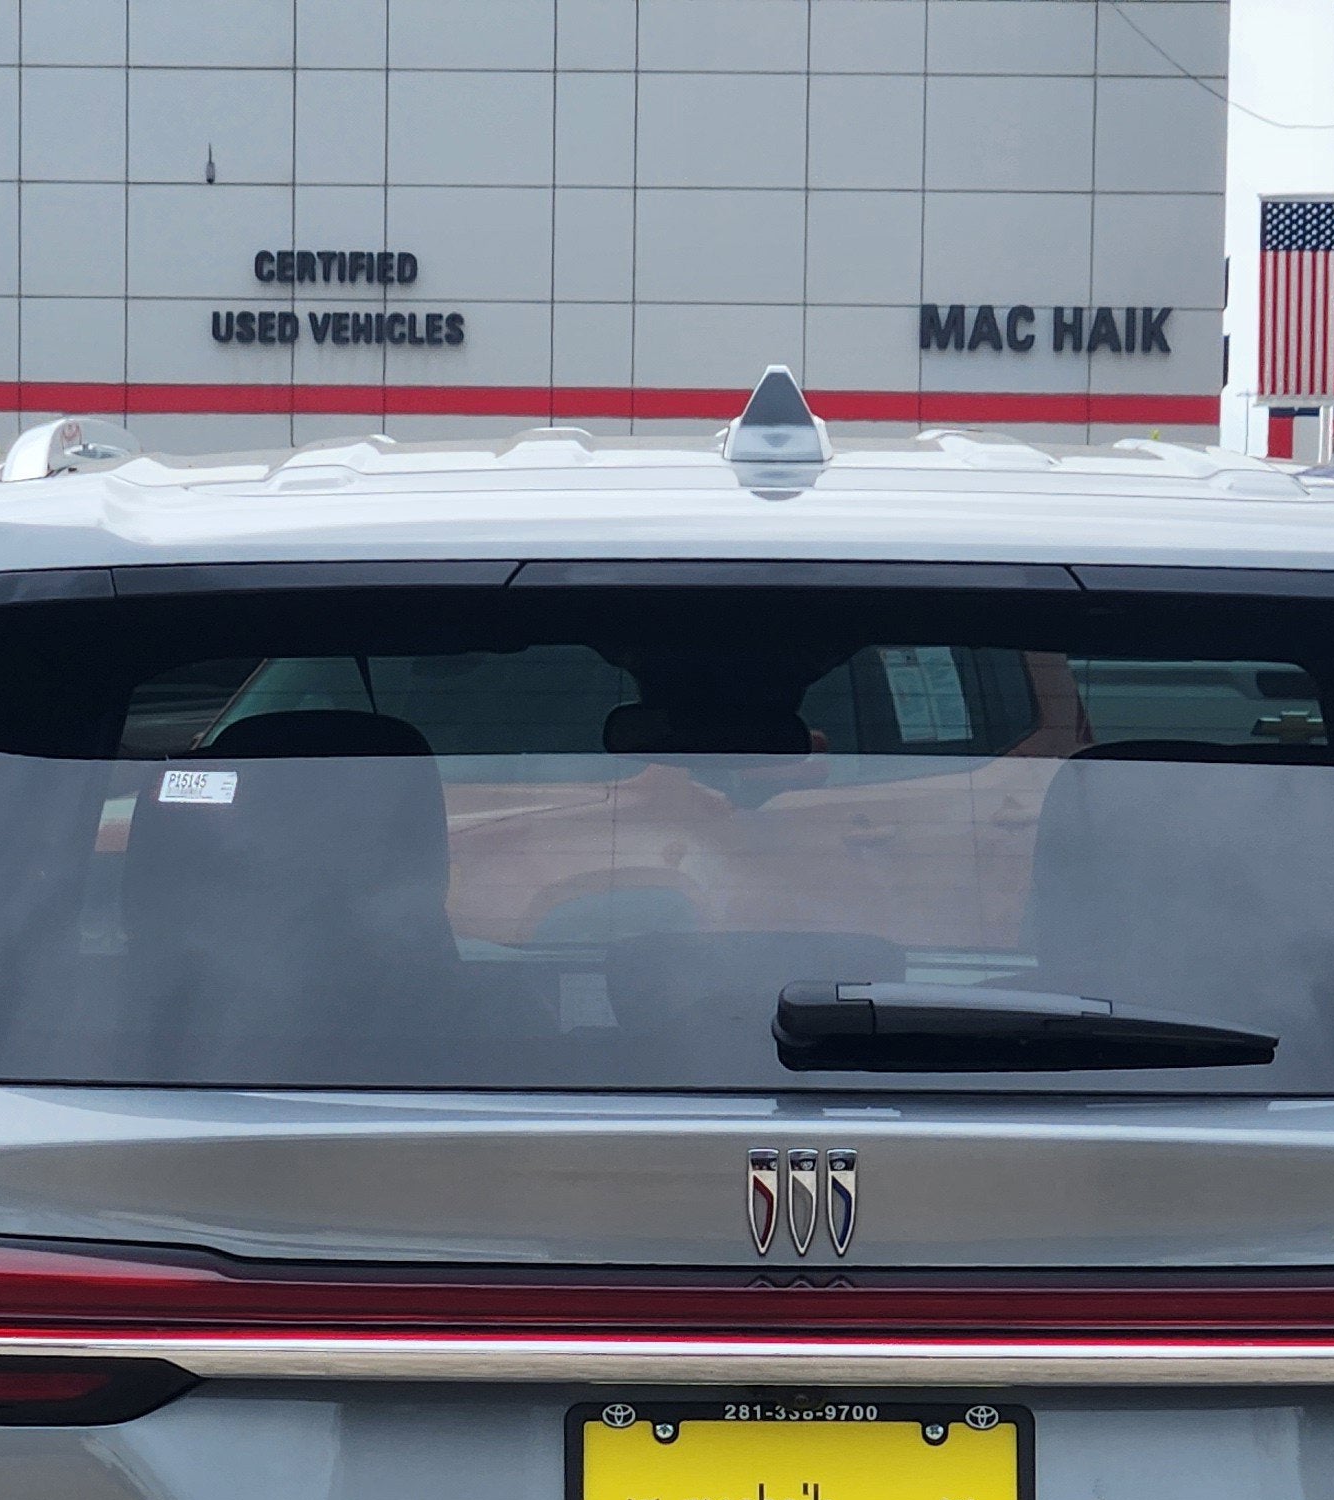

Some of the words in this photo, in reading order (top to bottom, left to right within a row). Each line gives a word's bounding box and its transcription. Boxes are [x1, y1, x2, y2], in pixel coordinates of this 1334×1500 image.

[254, 249, 418, 283] CERTIFIED
[212, 311, 300, 344] USED
[308, 312, 465, 346] VEHICLES
[920, 304, 1035, 351] MAC
[1053, 306, 1173, 354] HAIK
